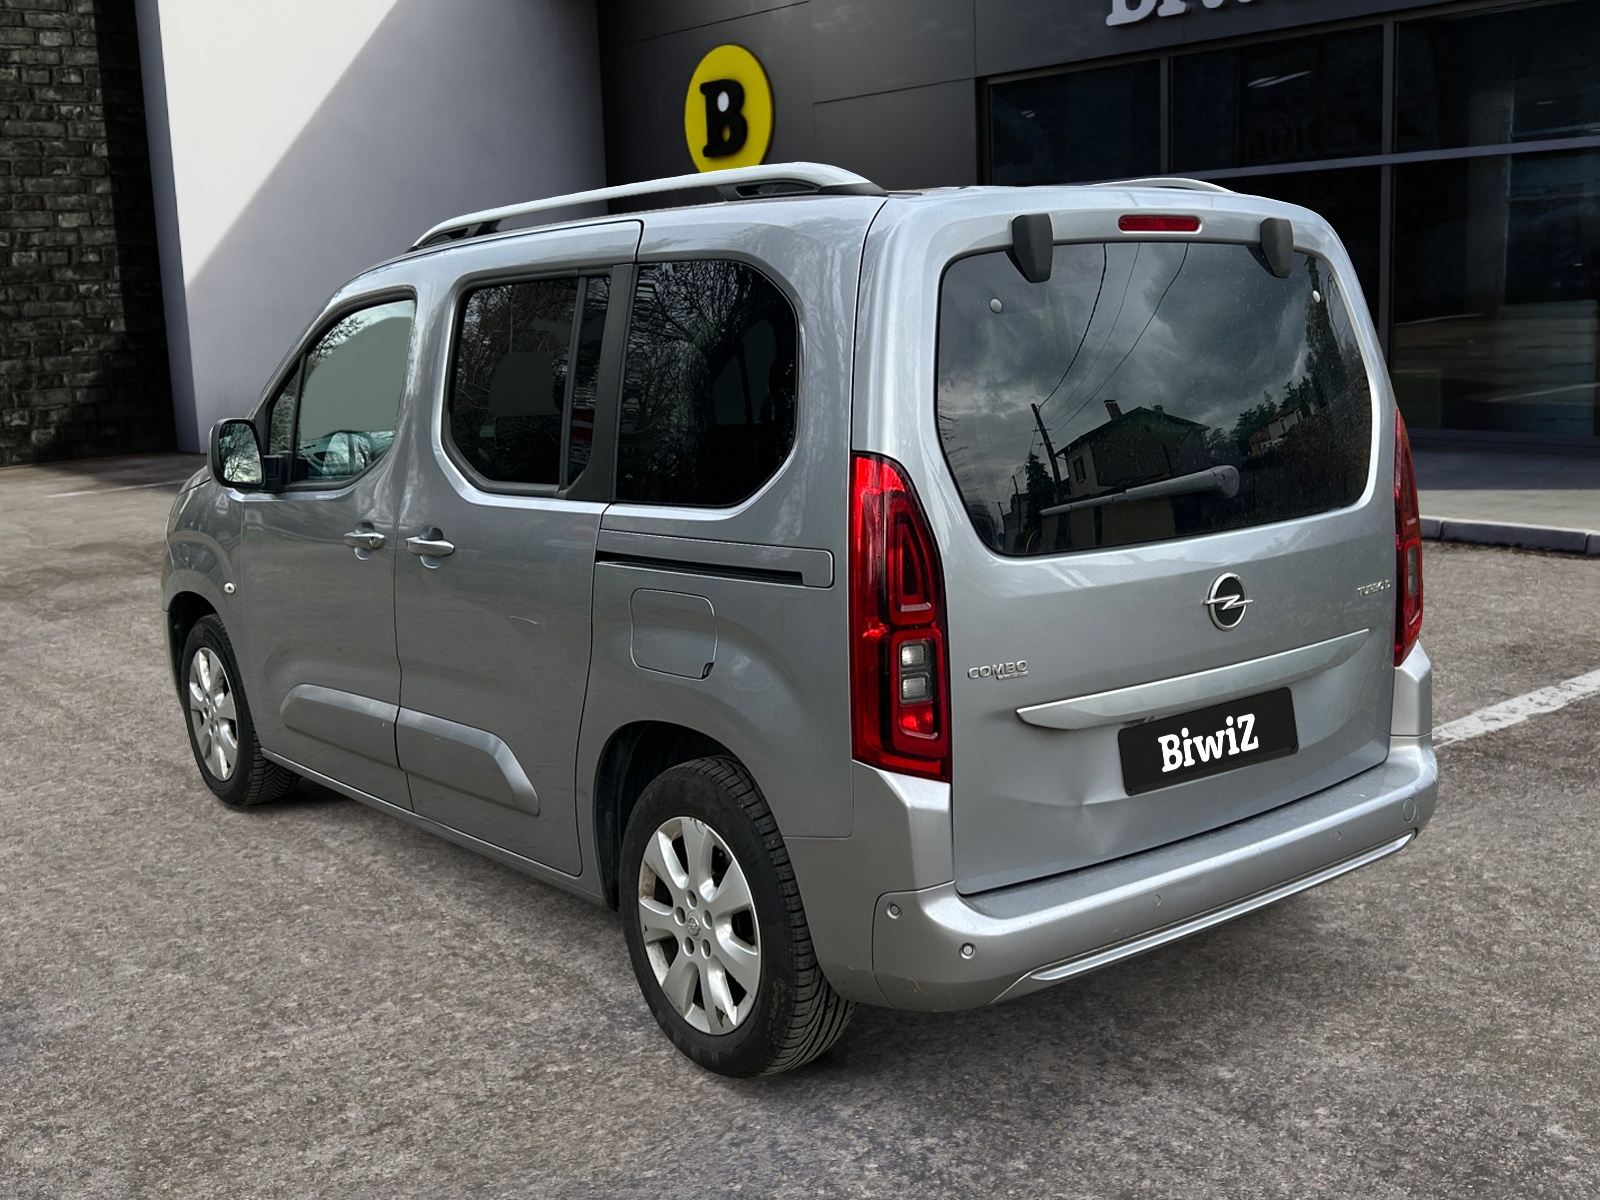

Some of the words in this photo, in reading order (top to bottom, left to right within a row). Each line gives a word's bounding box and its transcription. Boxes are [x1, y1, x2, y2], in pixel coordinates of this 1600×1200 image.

[700, 79, 748, 158] B
[968, 660, 1027, 679] COMBO
[1157, 713, 1260, 773] BiwiZ
